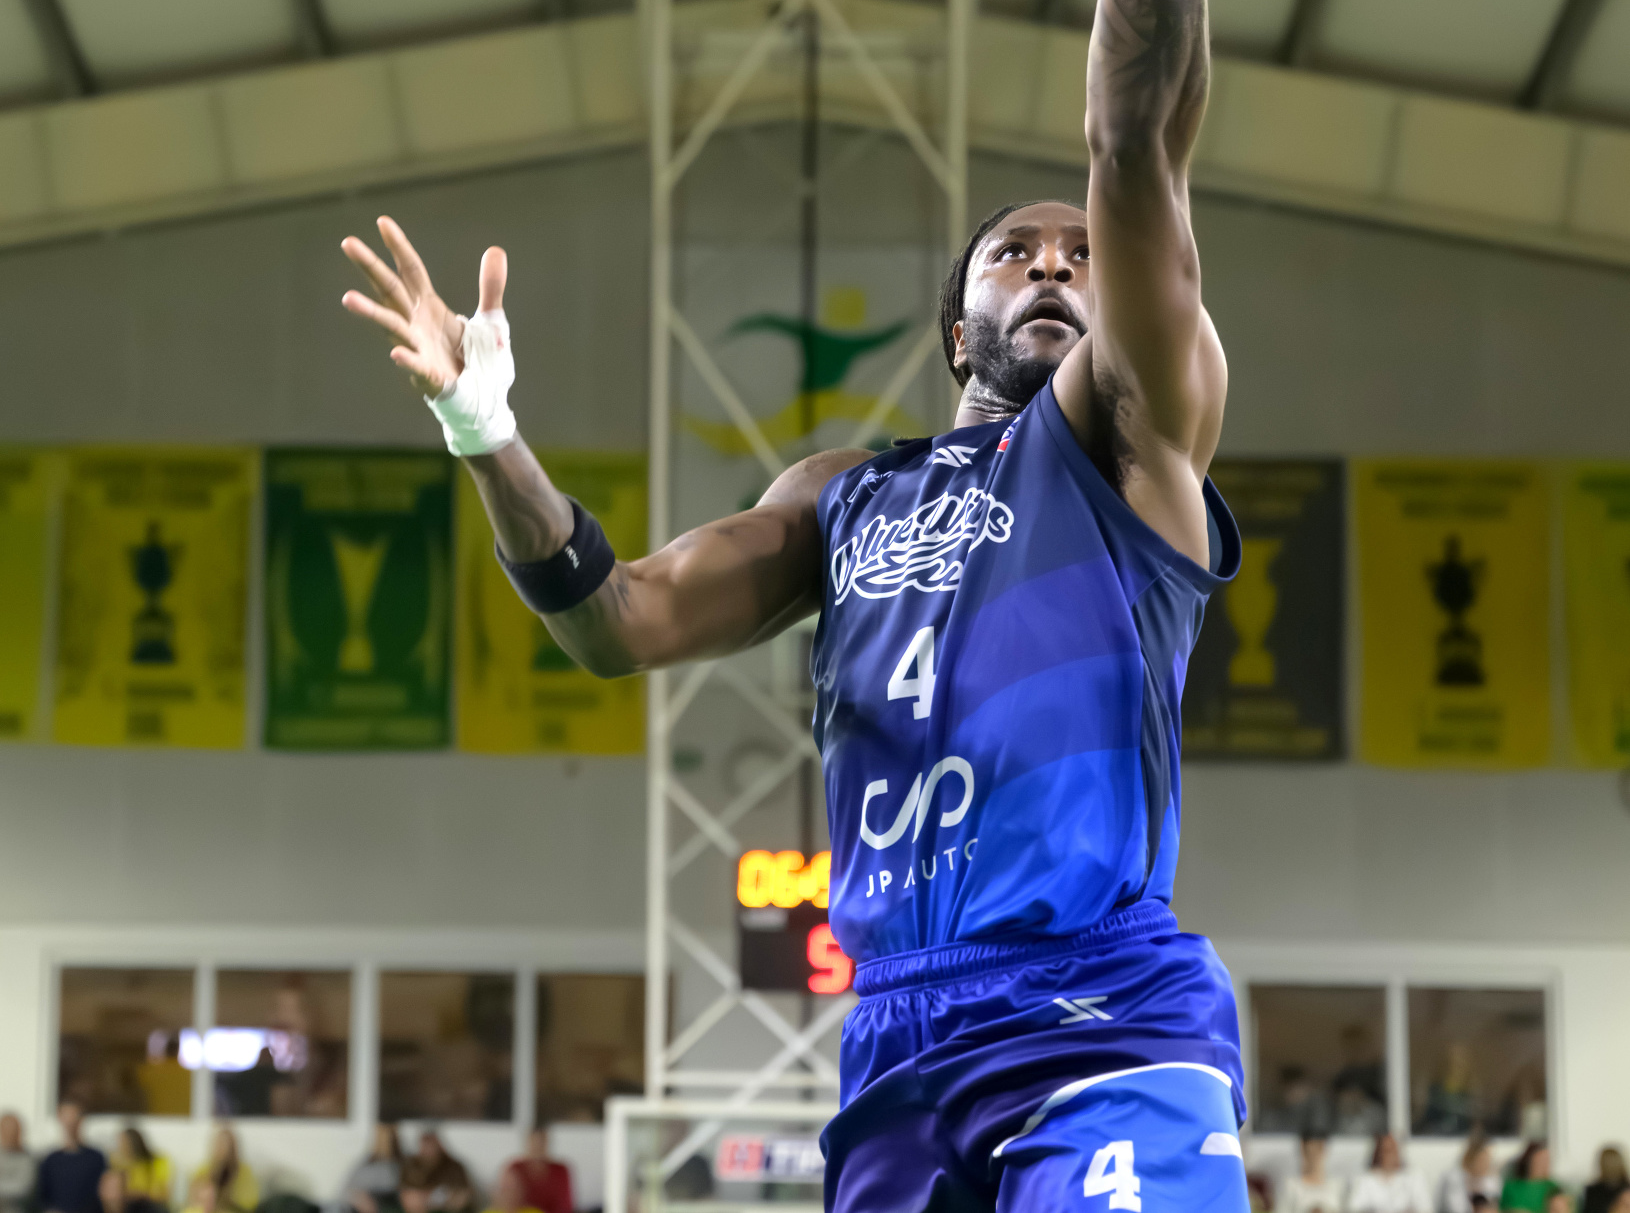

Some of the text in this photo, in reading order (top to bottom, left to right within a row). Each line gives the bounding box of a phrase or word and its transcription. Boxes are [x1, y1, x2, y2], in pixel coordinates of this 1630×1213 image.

[887, 626, 937, 720] 4
[866, 870, 893, 898] JP
[1083, 1140, 1142, 1213] 4
